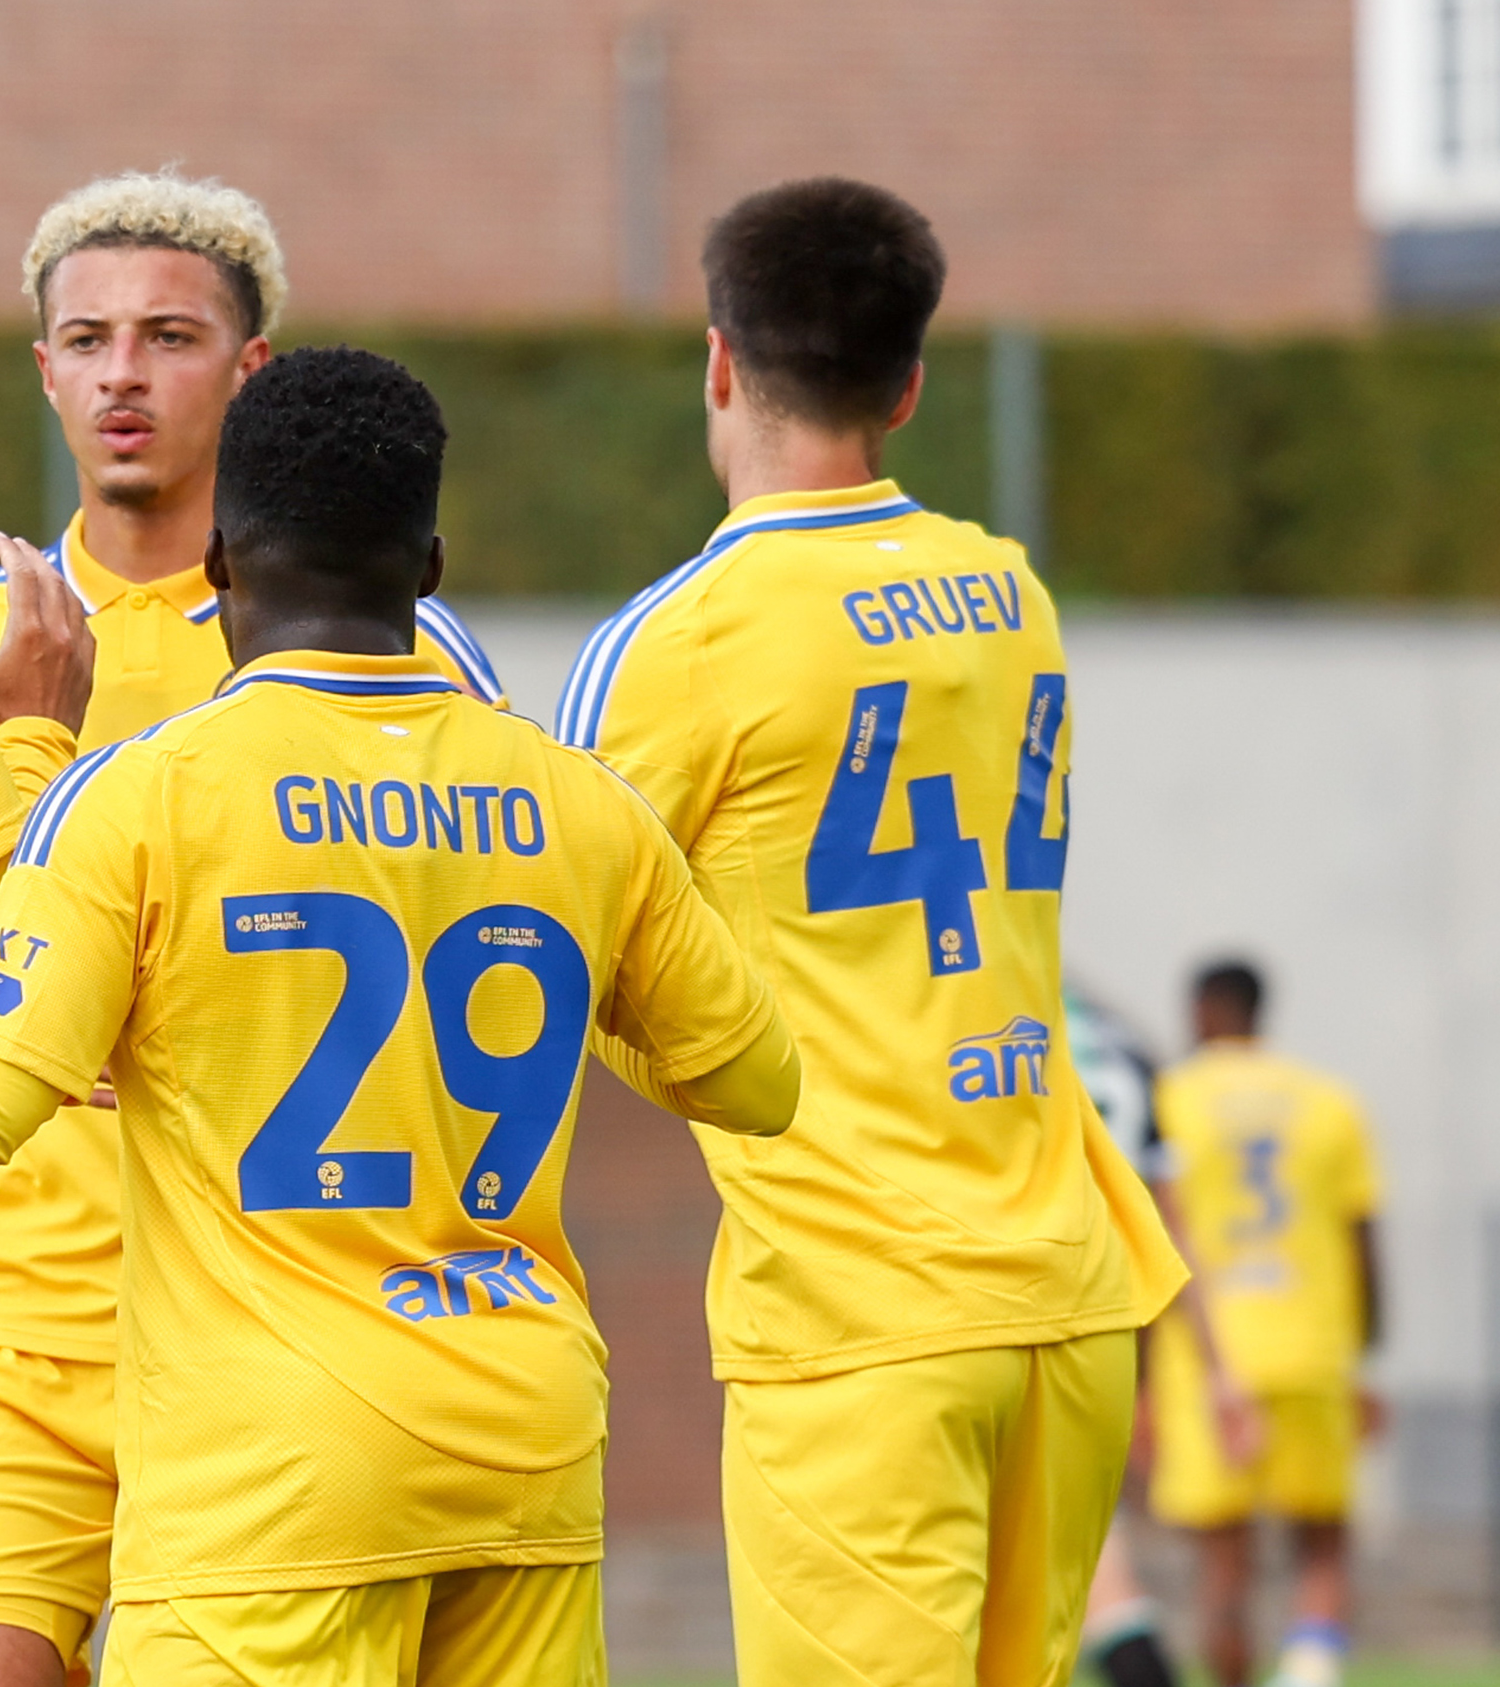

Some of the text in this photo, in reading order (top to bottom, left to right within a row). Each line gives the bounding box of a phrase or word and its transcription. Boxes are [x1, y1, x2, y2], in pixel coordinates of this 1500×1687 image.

[843, 571, 1022, 646] GRUEV
[275, 774, 545, 857] GNONTO
[942, 953, 964, 966] EFL
[222, 891, 592, 1221] 29
[948, 1038, 1050, 1103] am
[321, 1187, 343, 1200] EFL
[477, 1198, 498, 1211] EFL
[380, 1246, 558, 1323] amt
